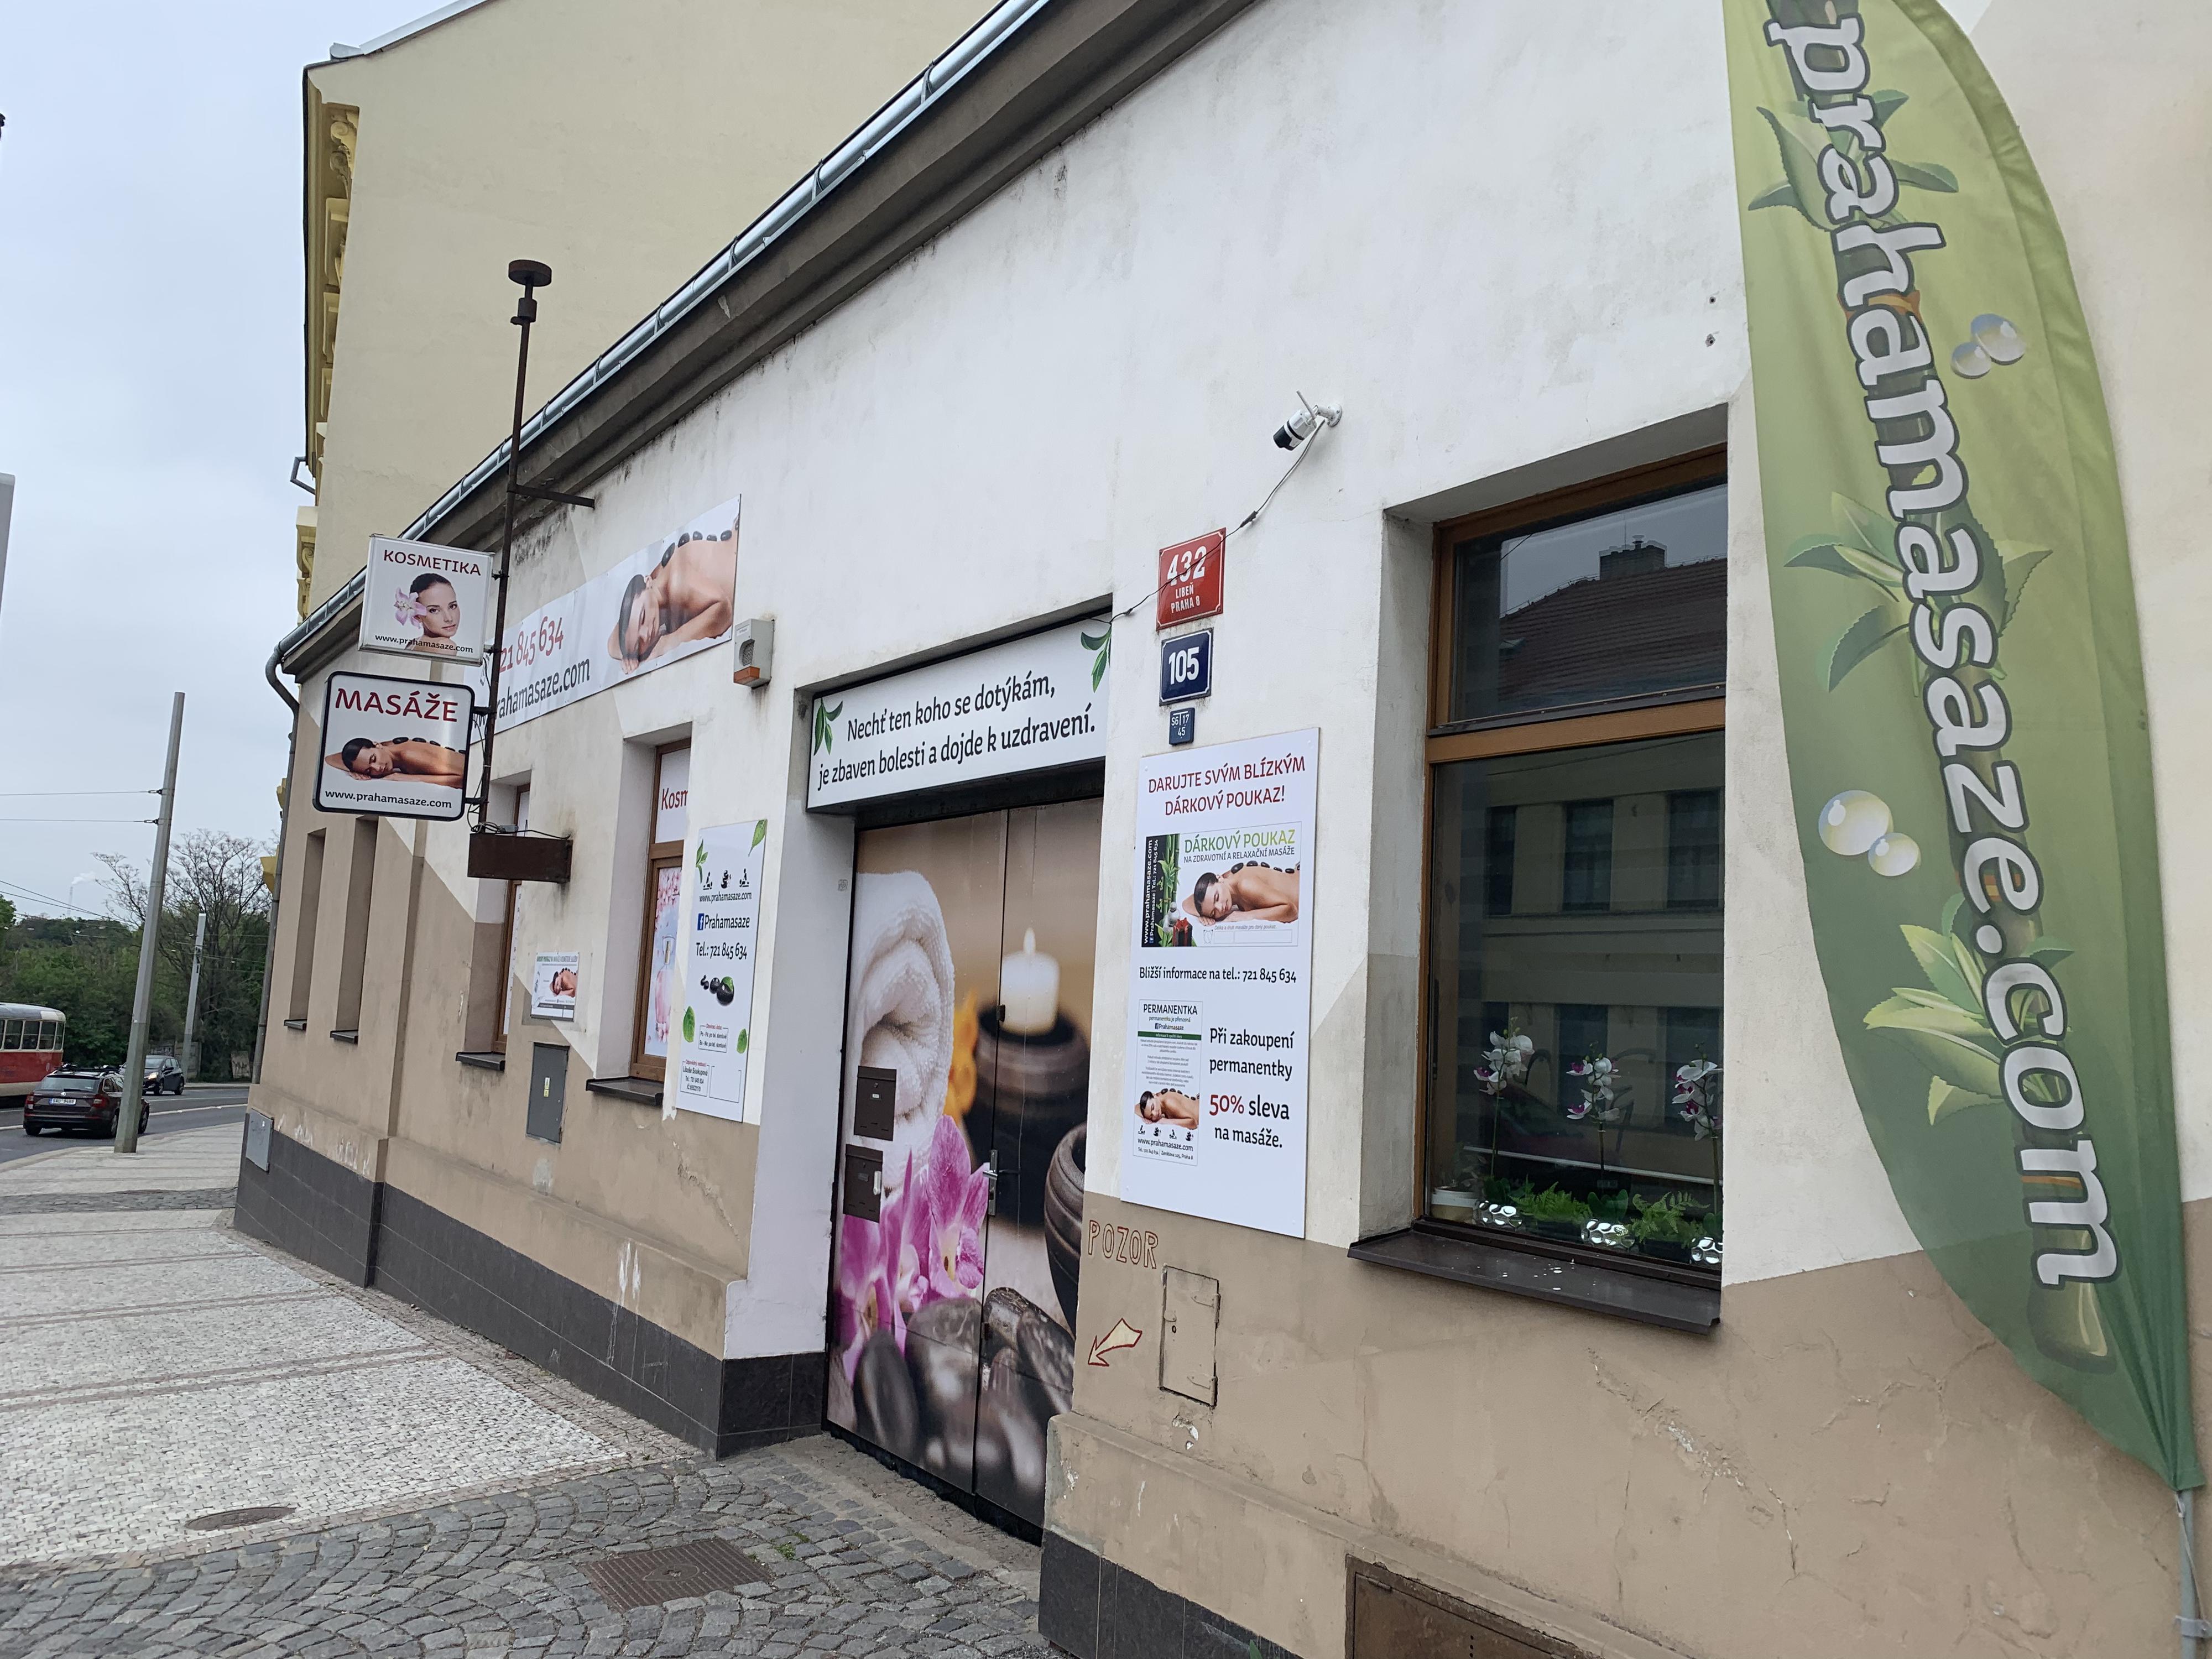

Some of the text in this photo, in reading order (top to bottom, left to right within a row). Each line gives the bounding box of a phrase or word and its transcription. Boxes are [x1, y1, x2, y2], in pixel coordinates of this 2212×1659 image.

[384, 550, 481, 576] KOSMETIKA
[1167, 545, 1207, 586] 432
[1176, 582, 1194, 599] LIBEŇ
[1171, 595, 1201, 614] PRAHA 8
[375, 635, 473, 653] www.prahamasaze.com
[499, 616, 564, 673] 21 845 634
[1764, 13, 2122, 1290] prahamasaze.com
[1168, 646, 1199, 685] 105
[335, 688, 458, 722] MASÁŽE
[848, 670, 1055, 742] Nechť ten koho se dotýkám,
[818, 702, 1095, 791] je zbaven bolesti a dojde k uzdravení.
[1149, 753, 1305, 794] DARUJTE SVÝM BLÍZKÝM
[325, 790, 452, 808] www.prahamasaze.com
[1165, 785, 1285, 816] DÁRKOVÝ POUKAZ!
[1185, 829, 1295, 853] DÁRKOVÝ POUKAZ
[1193, 851, 1227, 863] ZDRAVOTNÍ
[1233, 847, 1267, 859] RELAXAČNÍ
[1268, 845, 1295, 857] MASÁŽE
[699, 891, 752, 904] www.prahamasaze.com
[1144, 839, 1152, 944] www.prahamasaze.com
[705, 914, 750, 929] Prahamasaze
[696, 941, 747, 960] Tel.: 721 845 634
[1140, 966, 1297, 983] Bližší informace na tel.: 721 845 634
[1143, 1004, 1198, 1015] PERMANENTKA
[1210, 1028, 1294, 1052] Při zakoupení
[1209, 1058, 1292, 1082] permanentky
[1209, 1094, 1290, 1120] 50% sleva
[1138, 1138, 1193, 1151] www.prahamasaze.com
[1215, 1126, 1282, 1148] na masáže.
[1088, 1219, 1159, 1269] POZOR
